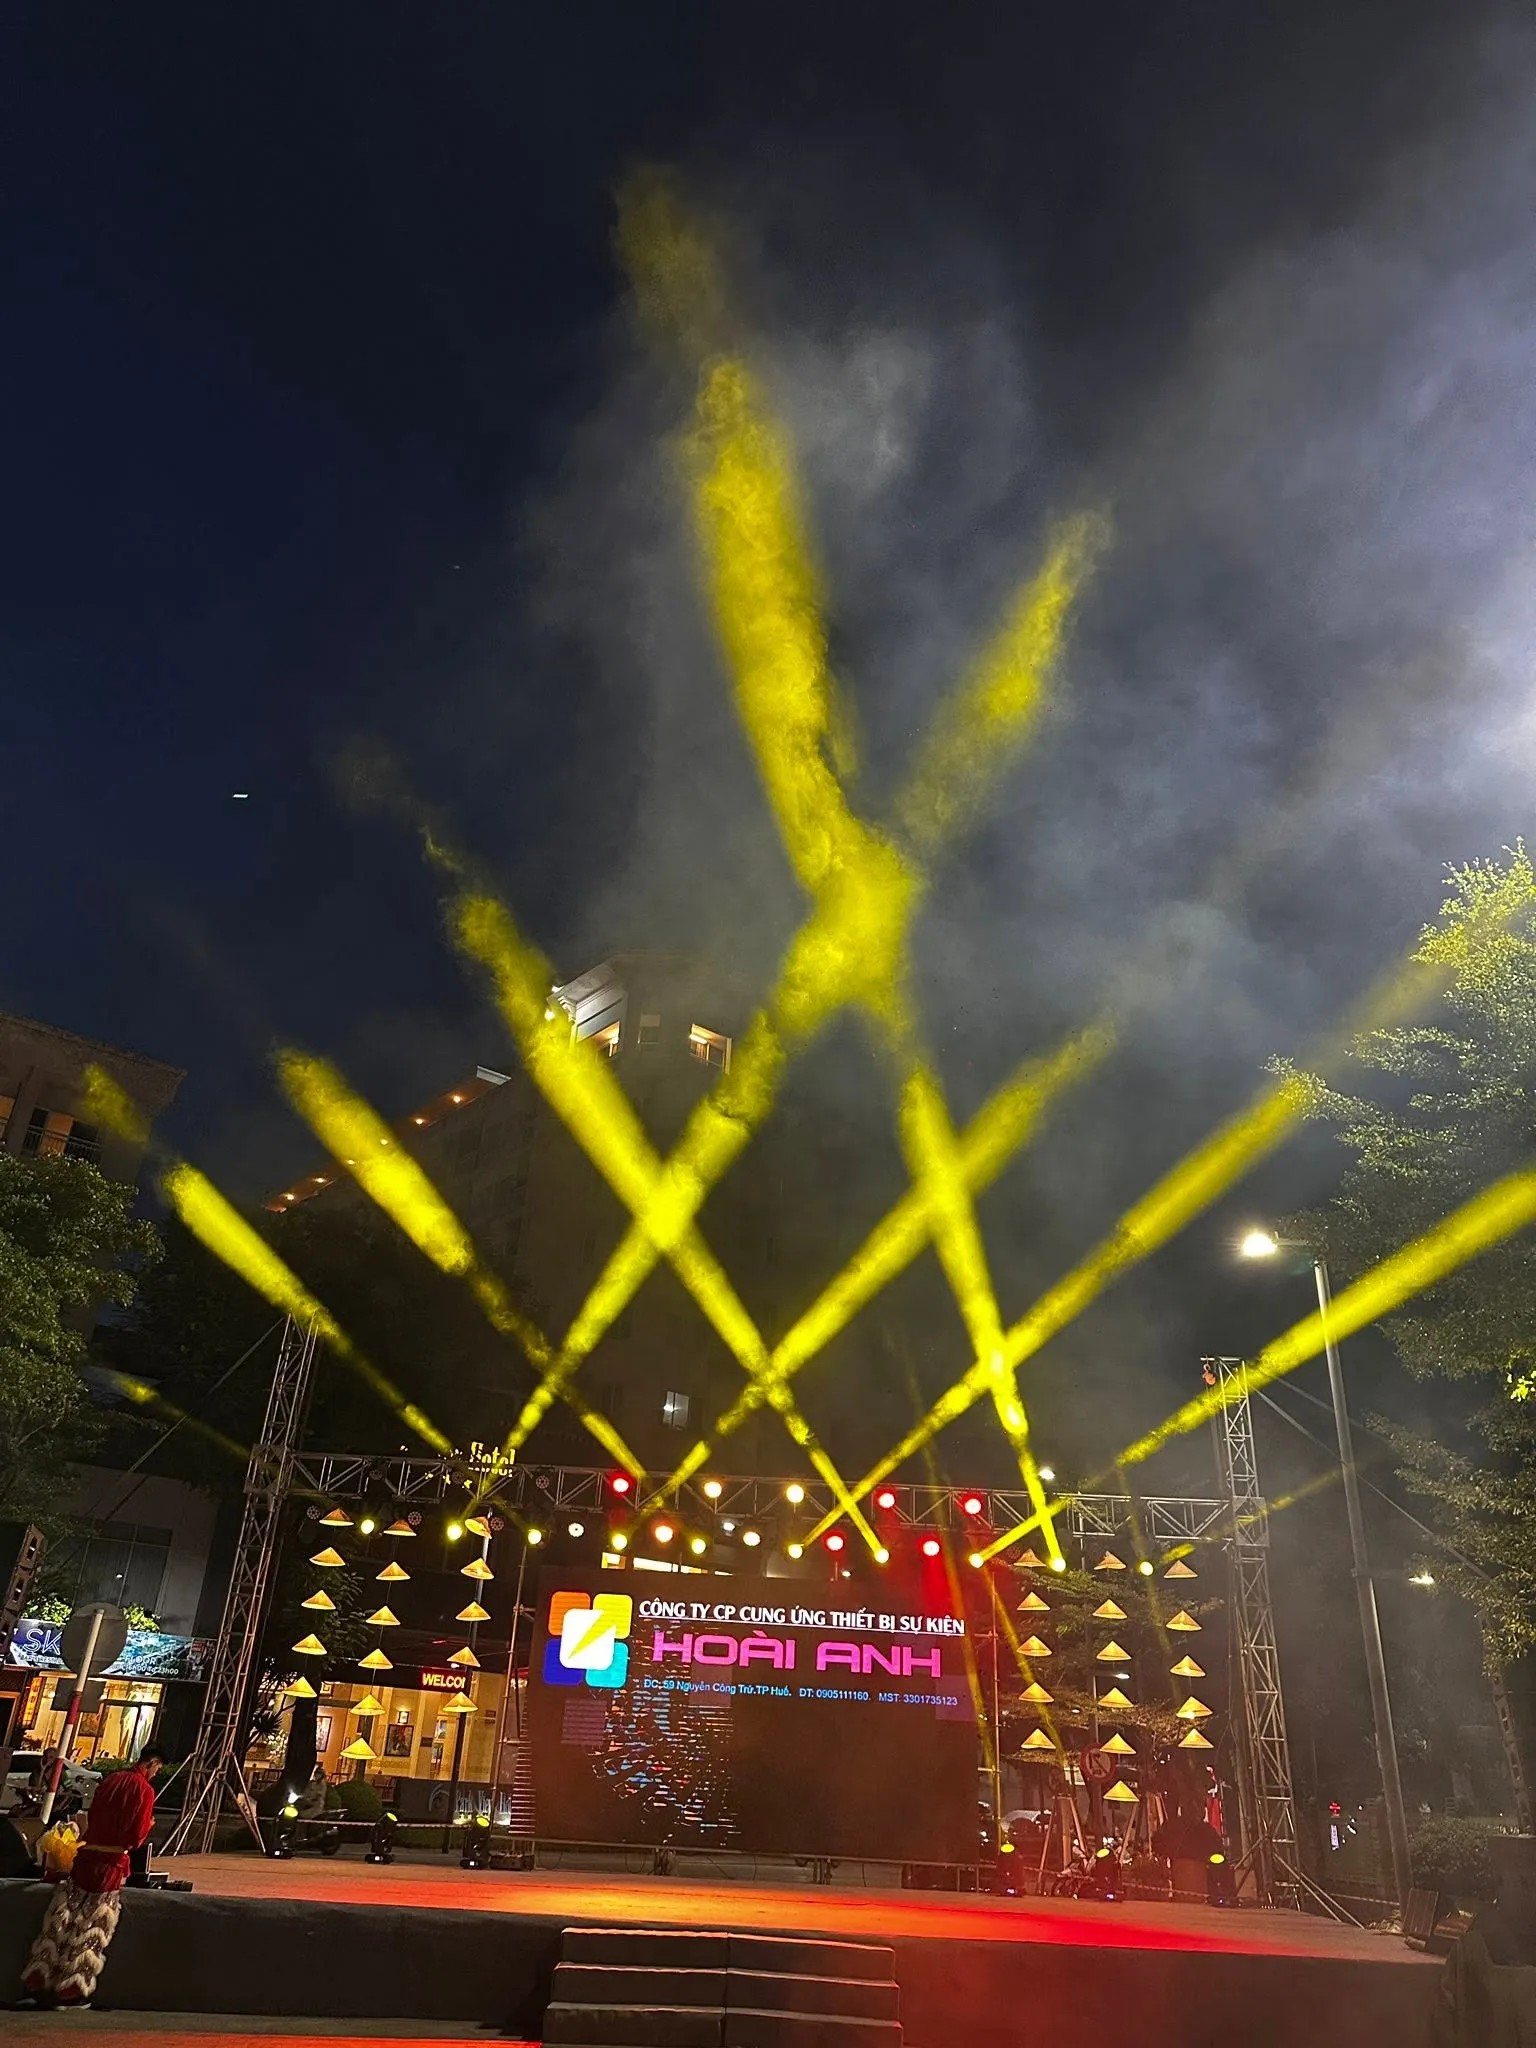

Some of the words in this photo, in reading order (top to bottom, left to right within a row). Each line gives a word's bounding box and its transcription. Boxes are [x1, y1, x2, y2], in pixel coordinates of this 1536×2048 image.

[639, 1598, 686, 1617] CÔNG
[690, 1603, 711, 1619] TY
[713, 1605, 736, 1620] CP
[739, 1607, 786, 1623] CUNG
[790, 1605, 826, 1626] ỨNG
[830, 1607, 875, 1629] THIẾT
[879, 1614, 895, 1633] BỊ
[900, 1615, 922, 1635] SỰ
[927, 1614, 965, 1636] KIỆN
[653, 1629, 796, 1669] HOÀI
[816, 1641, 941, 1678] ANH
[663, 1680, 675, 1690] 59
[712, 1682, 737, 1695] Công
[903, 1693, 958, 1706] 3301735123
